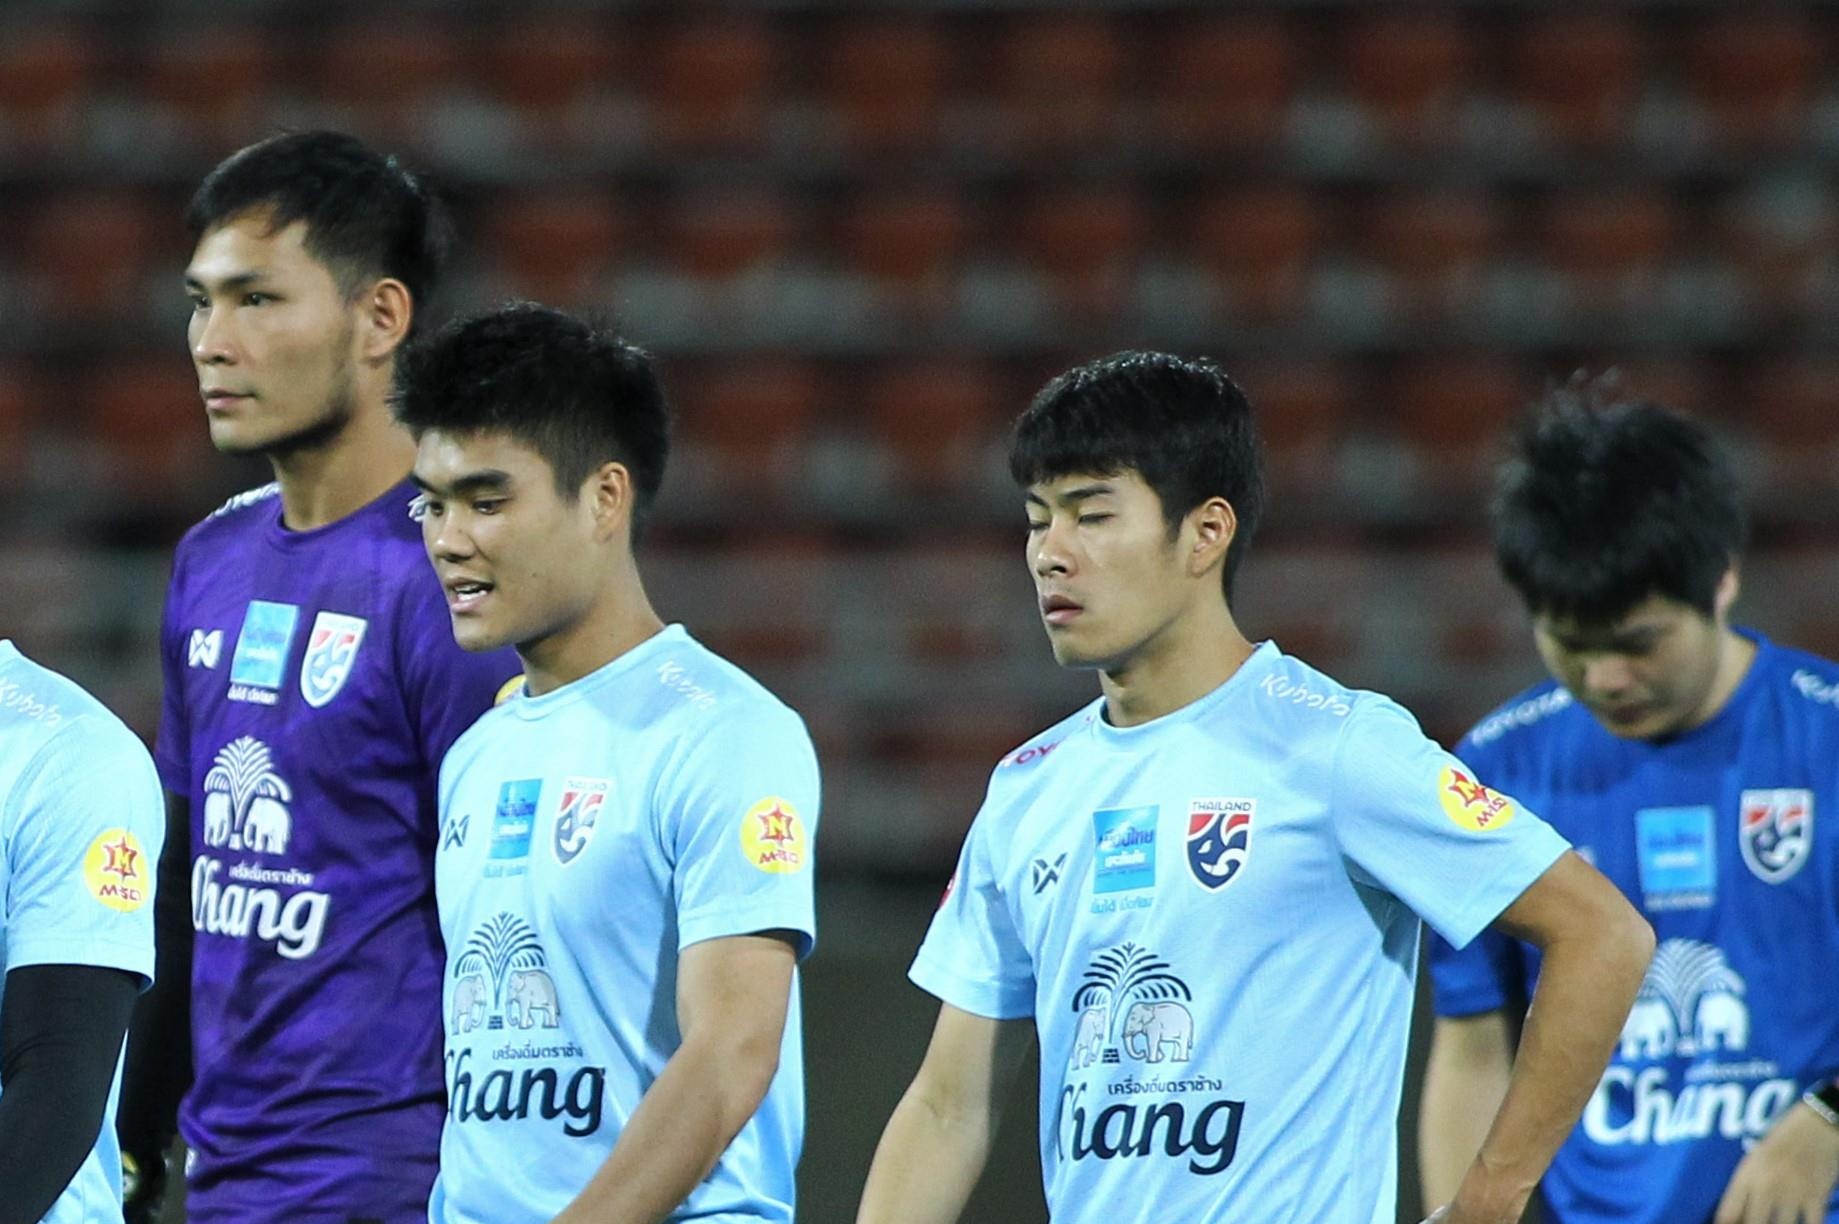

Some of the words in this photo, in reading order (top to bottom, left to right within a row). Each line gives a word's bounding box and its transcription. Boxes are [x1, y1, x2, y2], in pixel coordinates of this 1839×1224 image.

[1259, 673, 1352, 717] Kubota
[1192, 800, 1253, 813] THAILAND
[190, 854, 332, 960] Chang
